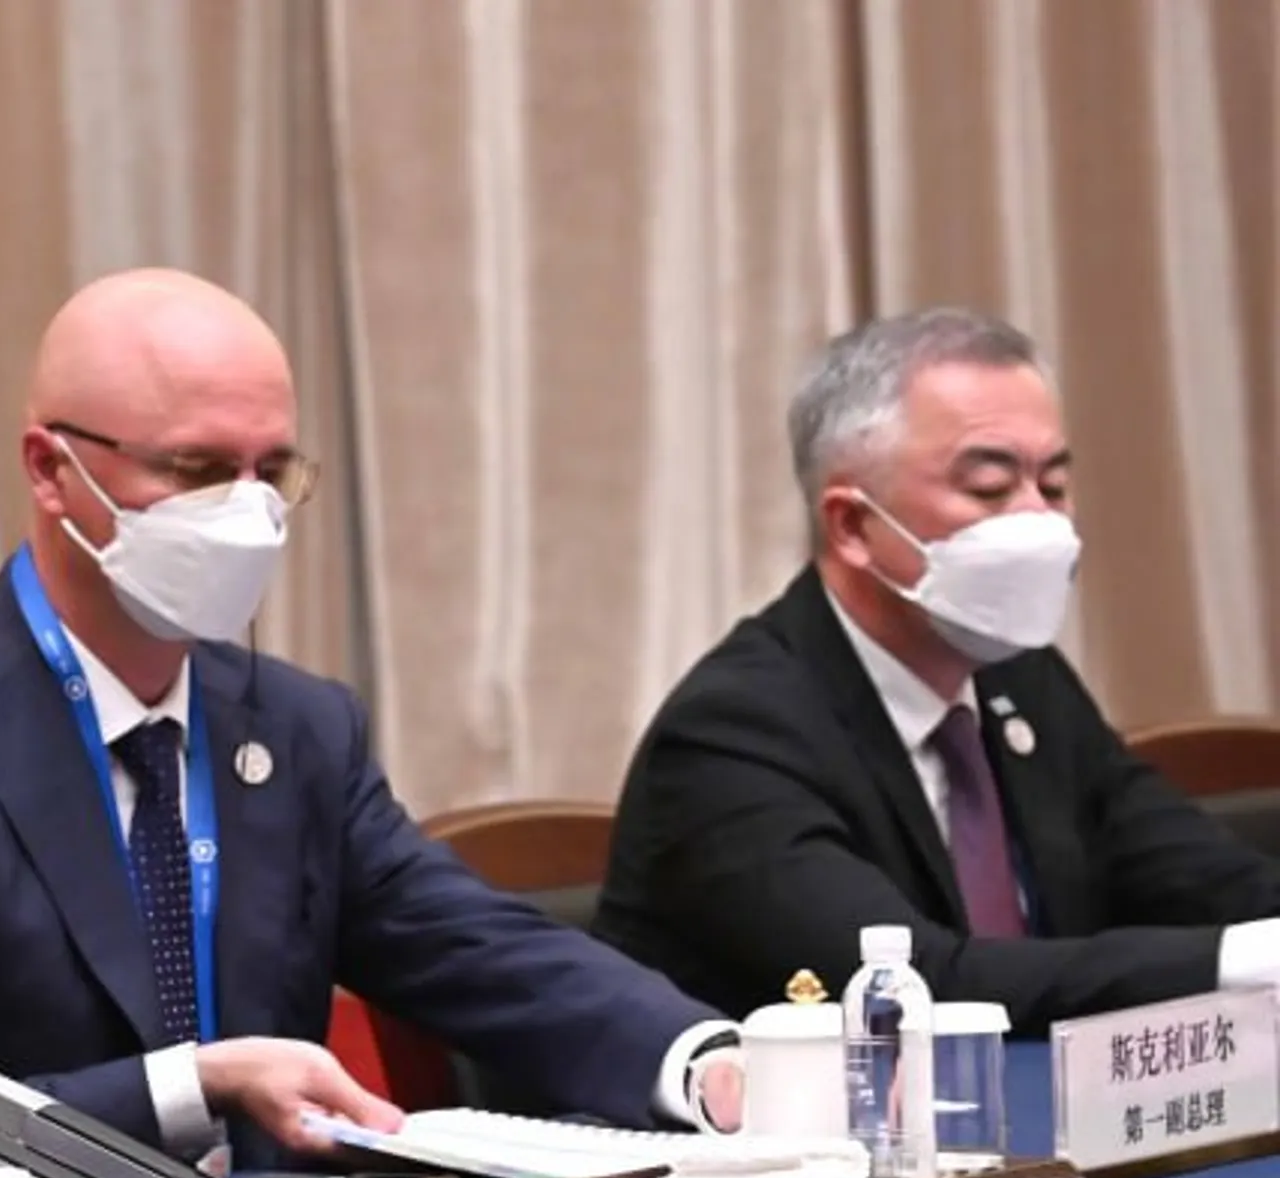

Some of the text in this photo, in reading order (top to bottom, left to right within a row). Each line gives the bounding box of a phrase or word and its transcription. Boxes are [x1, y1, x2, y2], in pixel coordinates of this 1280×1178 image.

[1110, 1014, 1236, 1081] 斯克利亚尔
[1124, 1088, 1227, 1145] 第一副总理
